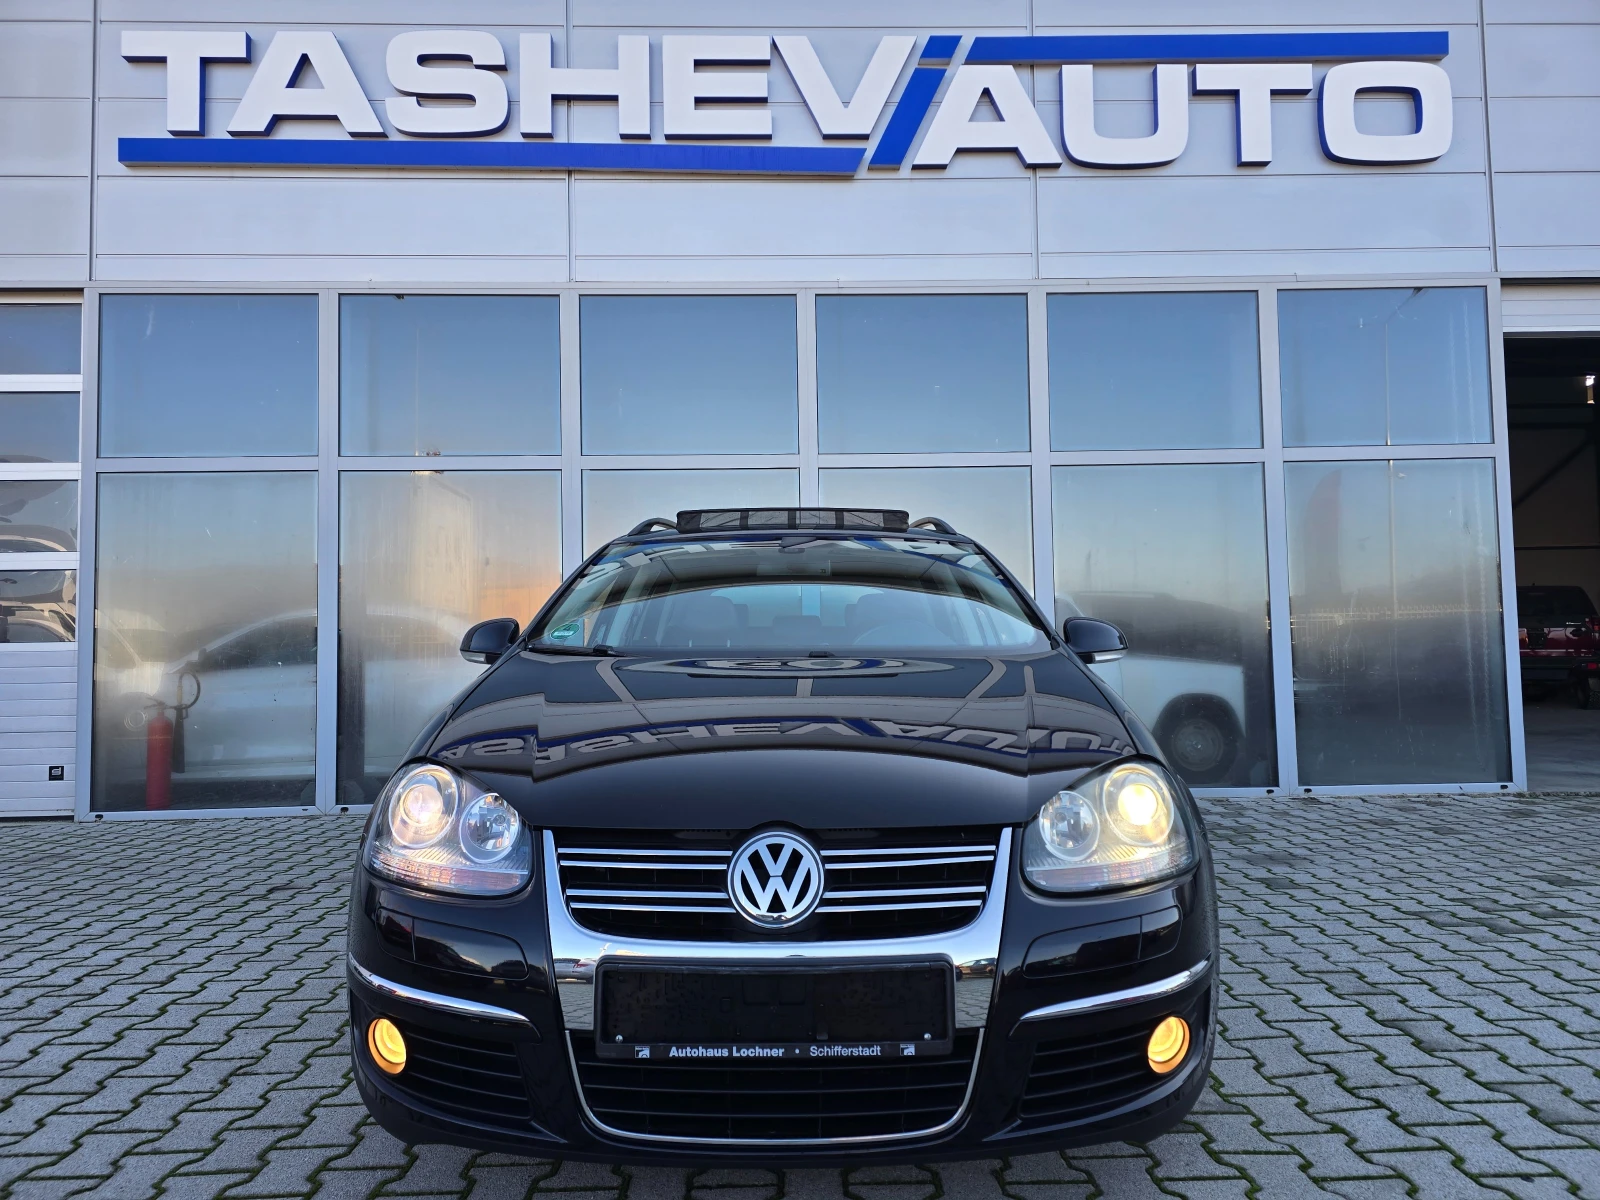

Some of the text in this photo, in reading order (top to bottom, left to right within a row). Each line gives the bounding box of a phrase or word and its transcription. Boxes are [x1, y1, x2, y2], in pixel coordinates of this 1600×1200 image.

[120, 30, 916, 139] TASHEV
[911, 61, 1453, 170] AUTO
[669, 1045, 881, 1057] Autohaus Lochner Schifferstadt
